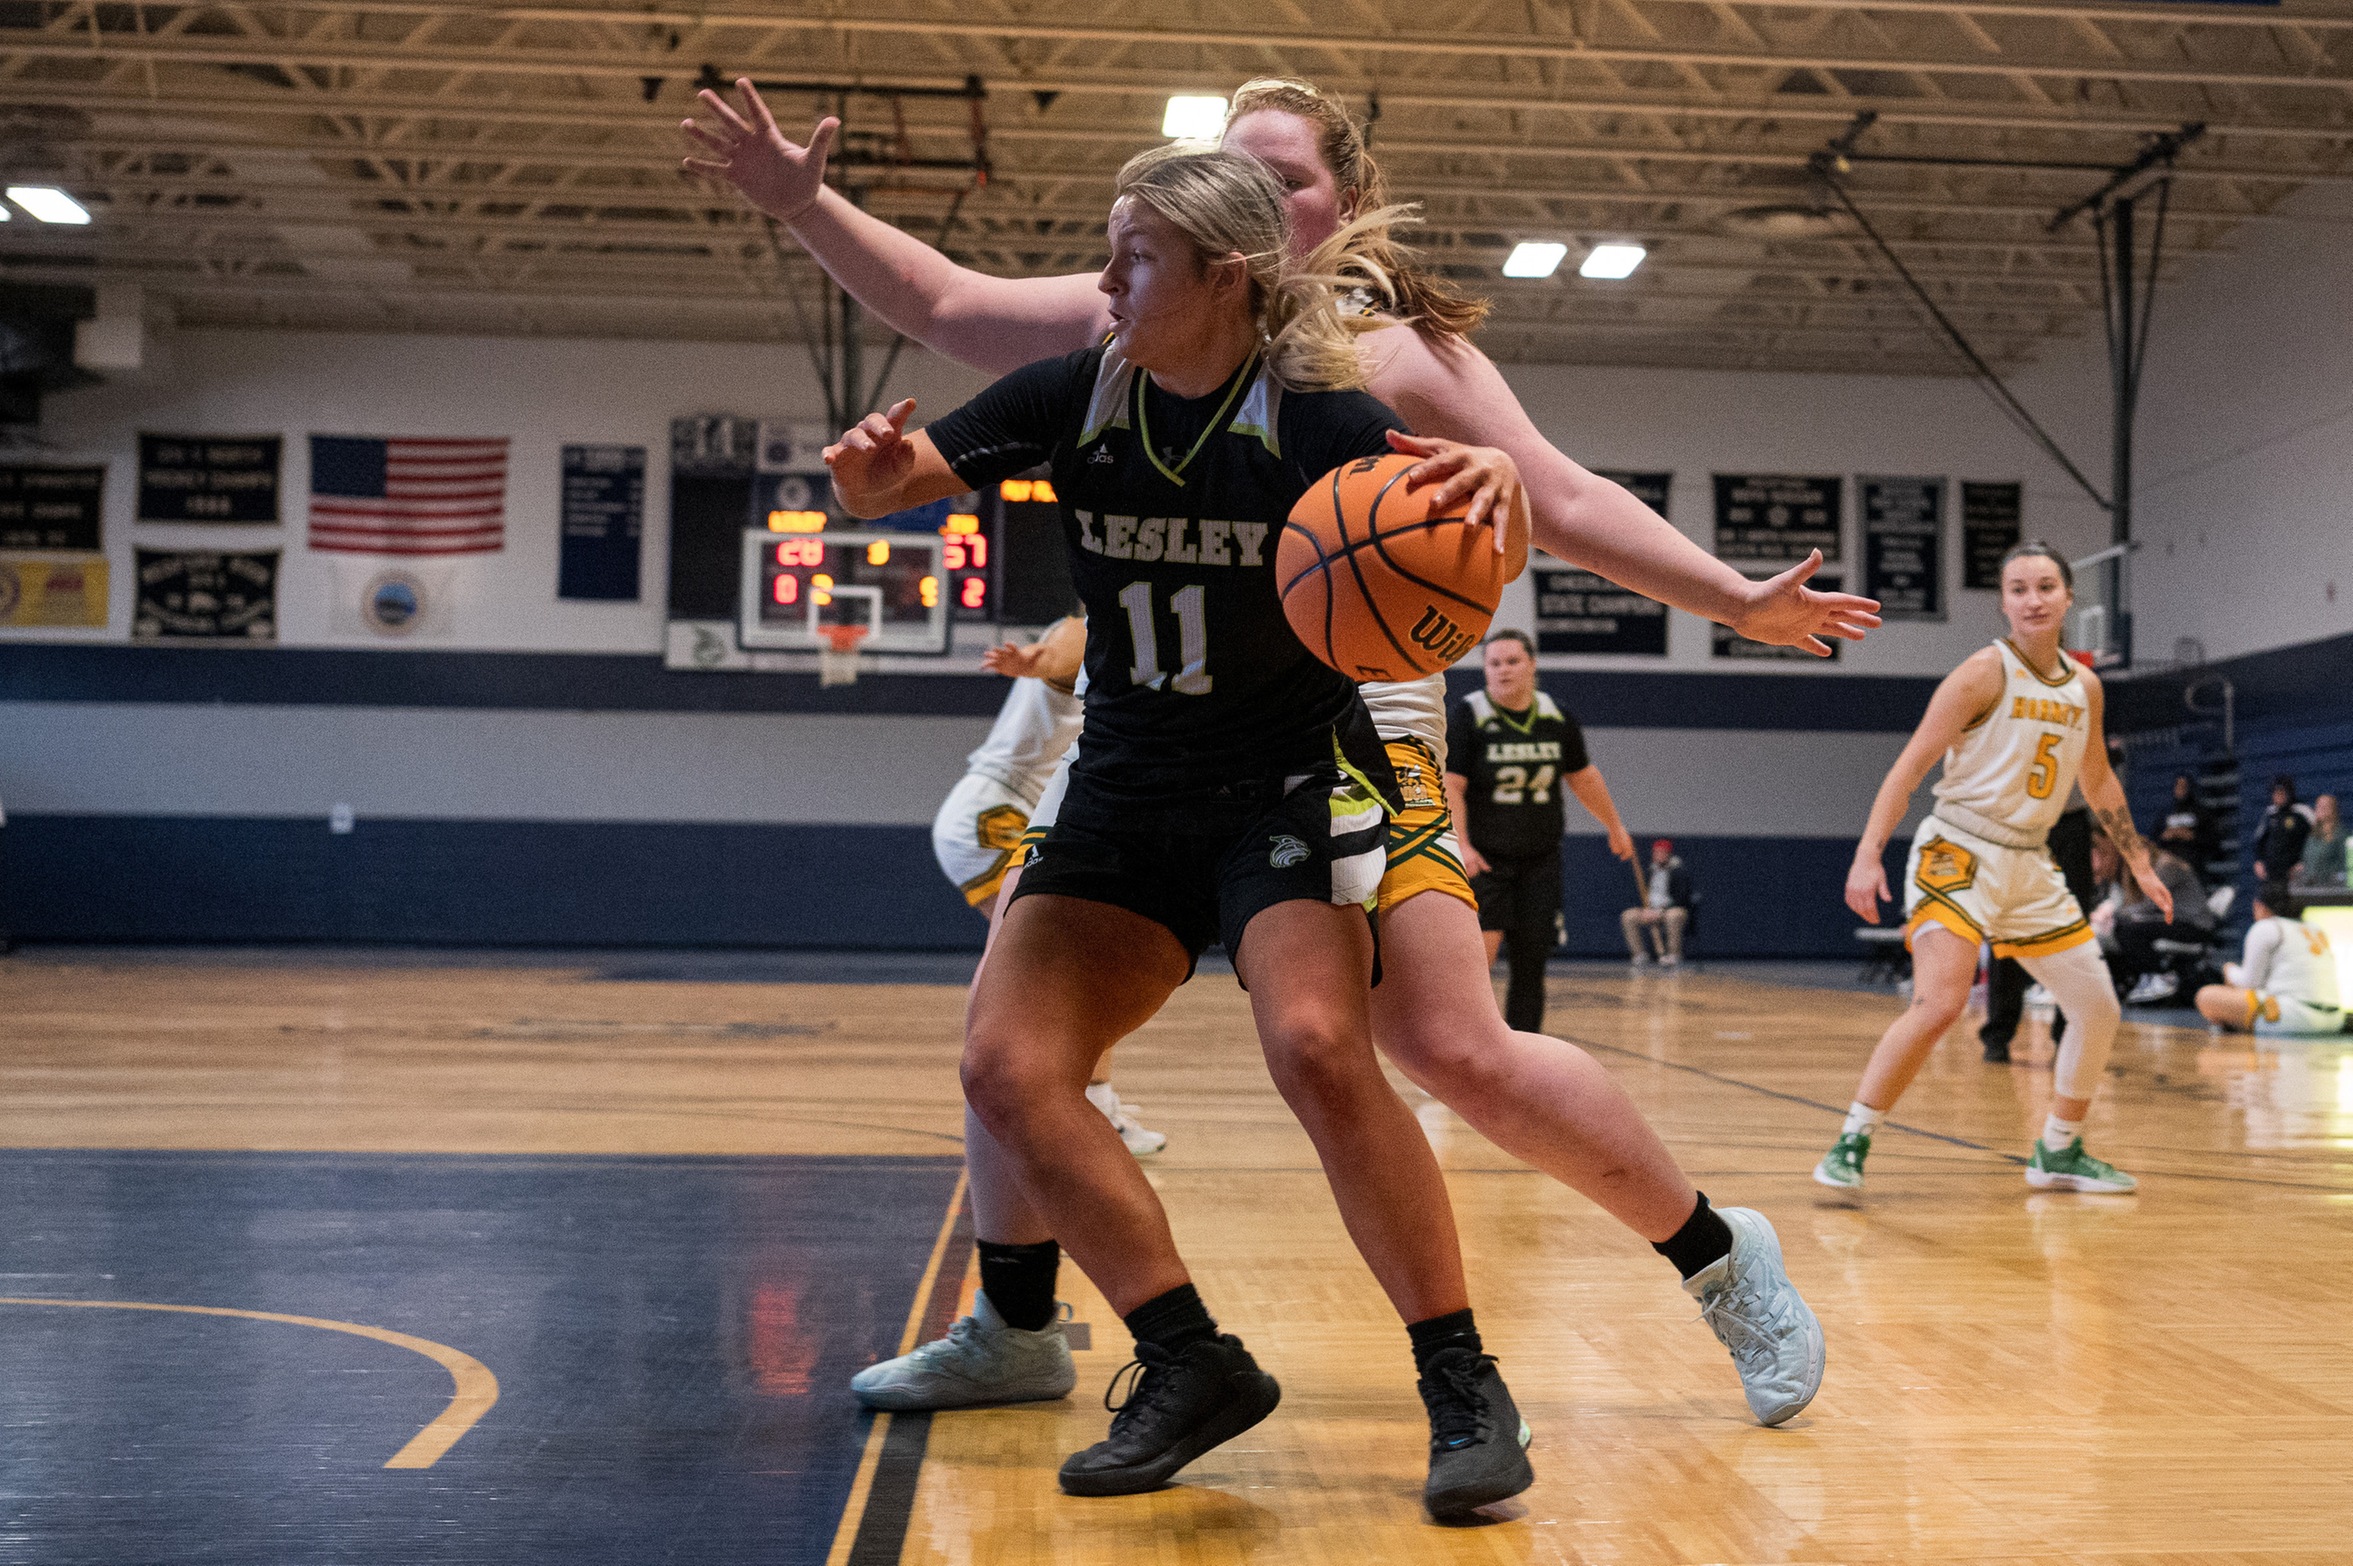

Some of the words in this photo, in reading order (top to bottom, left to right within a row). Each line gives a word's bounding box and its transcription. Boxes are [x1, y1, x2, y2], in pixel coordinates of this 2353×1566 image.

[943, 533, 987, 569] 57
[1075, 509, 1268, 566] LESLEY
[1119, 581, 1213, 695] 11
[1486, 742, 1561, 762] LESLEY
[2026, 732, 2063, 799] 5
[1493, 765, 1555, 803] 24
